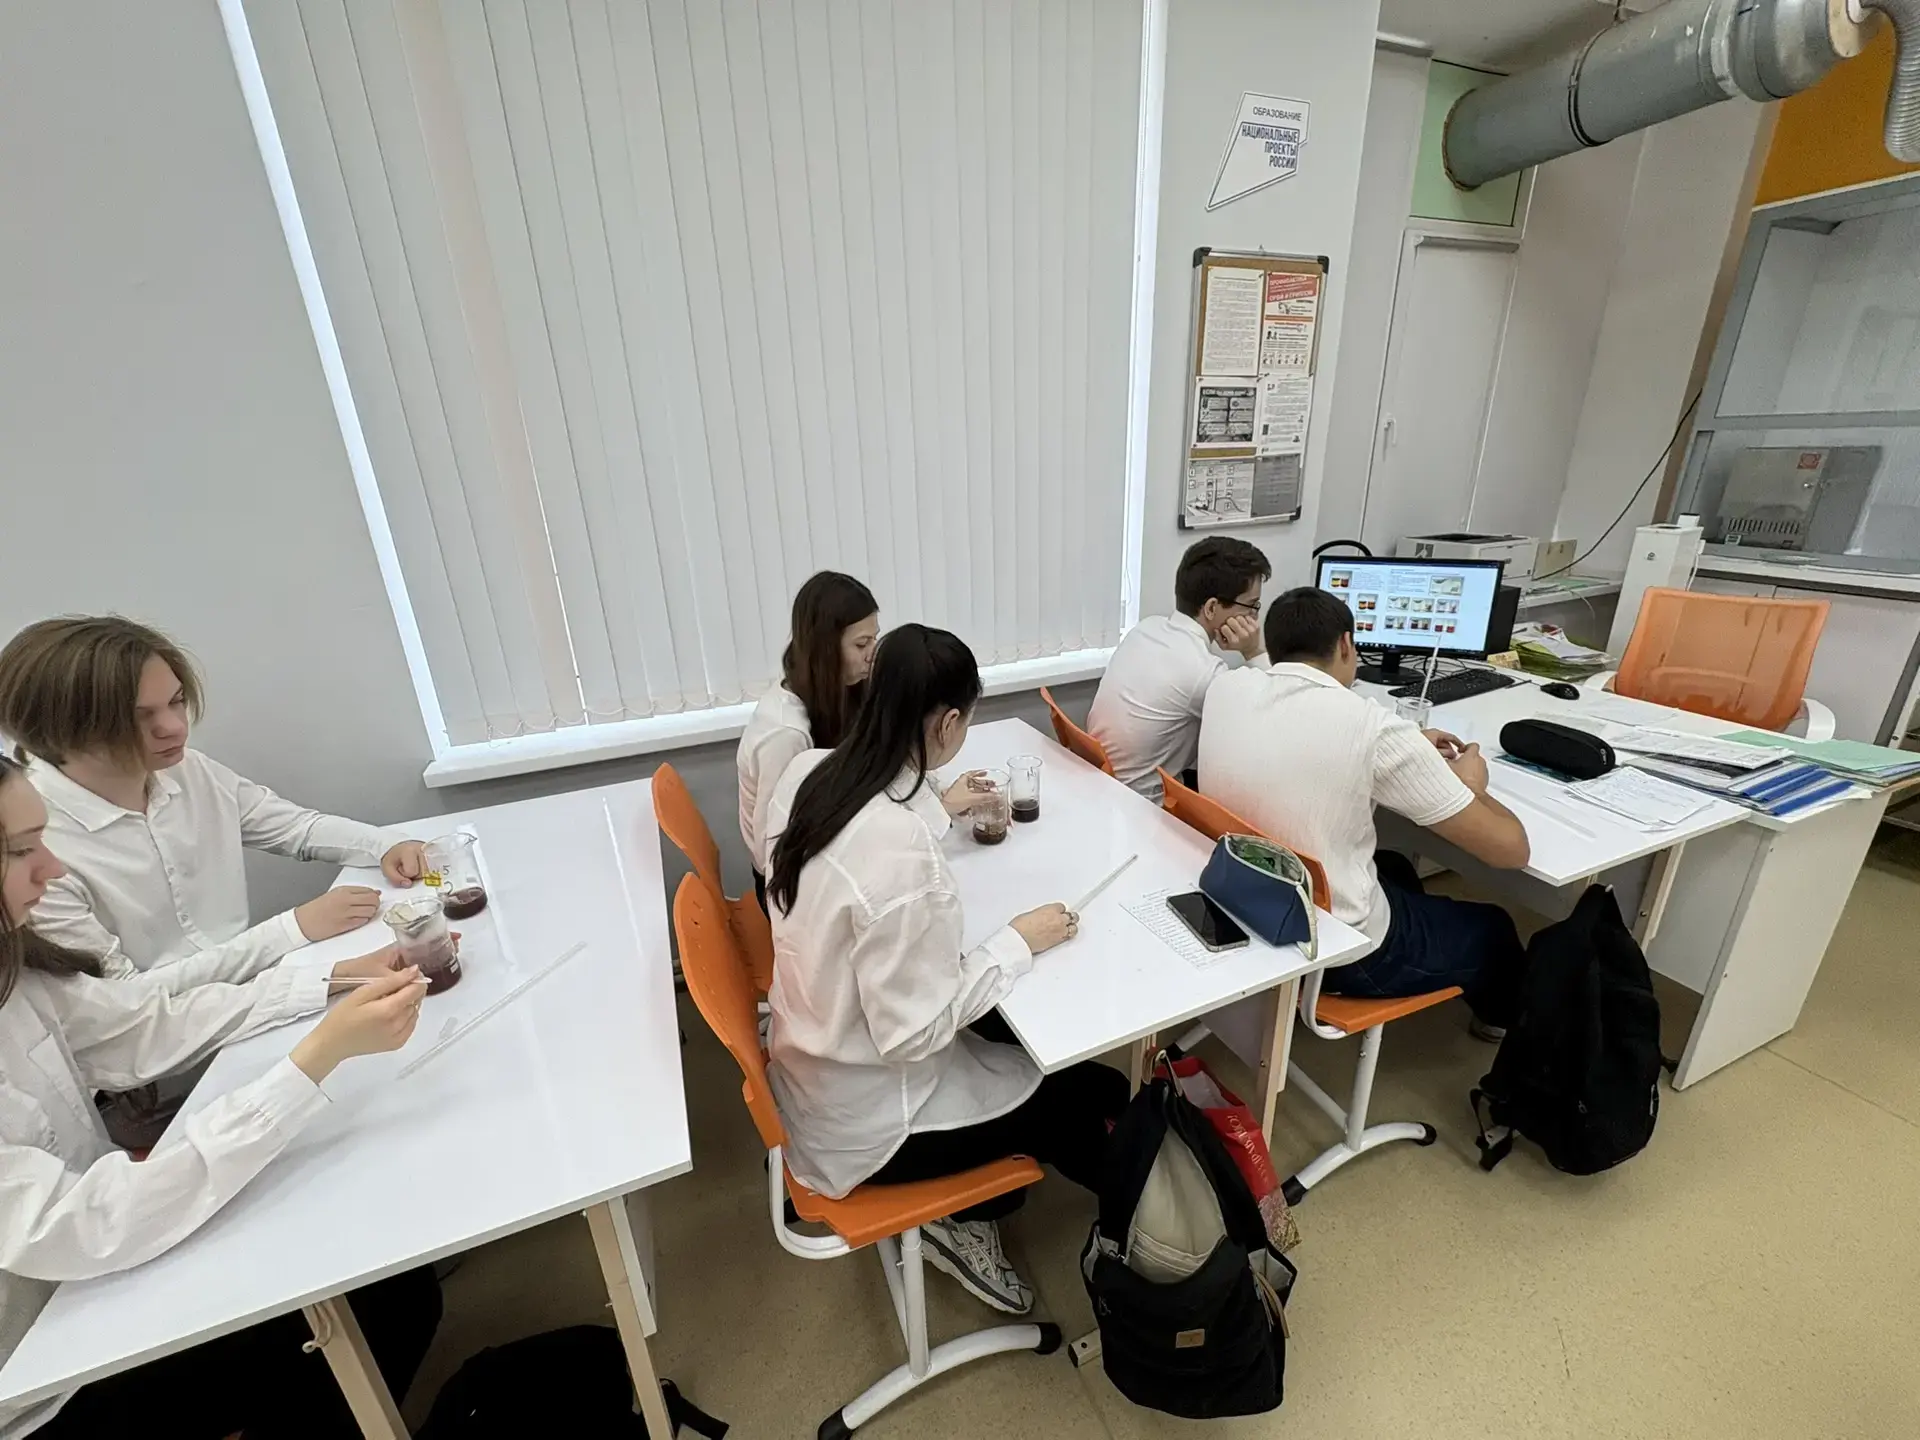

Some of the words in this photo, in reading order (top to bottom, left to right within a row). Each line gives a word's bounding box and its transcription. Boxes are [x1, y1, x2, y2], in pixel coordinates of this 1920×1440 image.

[1252, 106, 1302, 121] ОБРАЗОВАНИЕ
[1241, 124, 1298, 143] НАЦИОНАЛЬНЫЕ
[1264, 141, 1297, 156] ПРОЕКТЫ
[1268, 155, 1297, 169] РОССИИ
